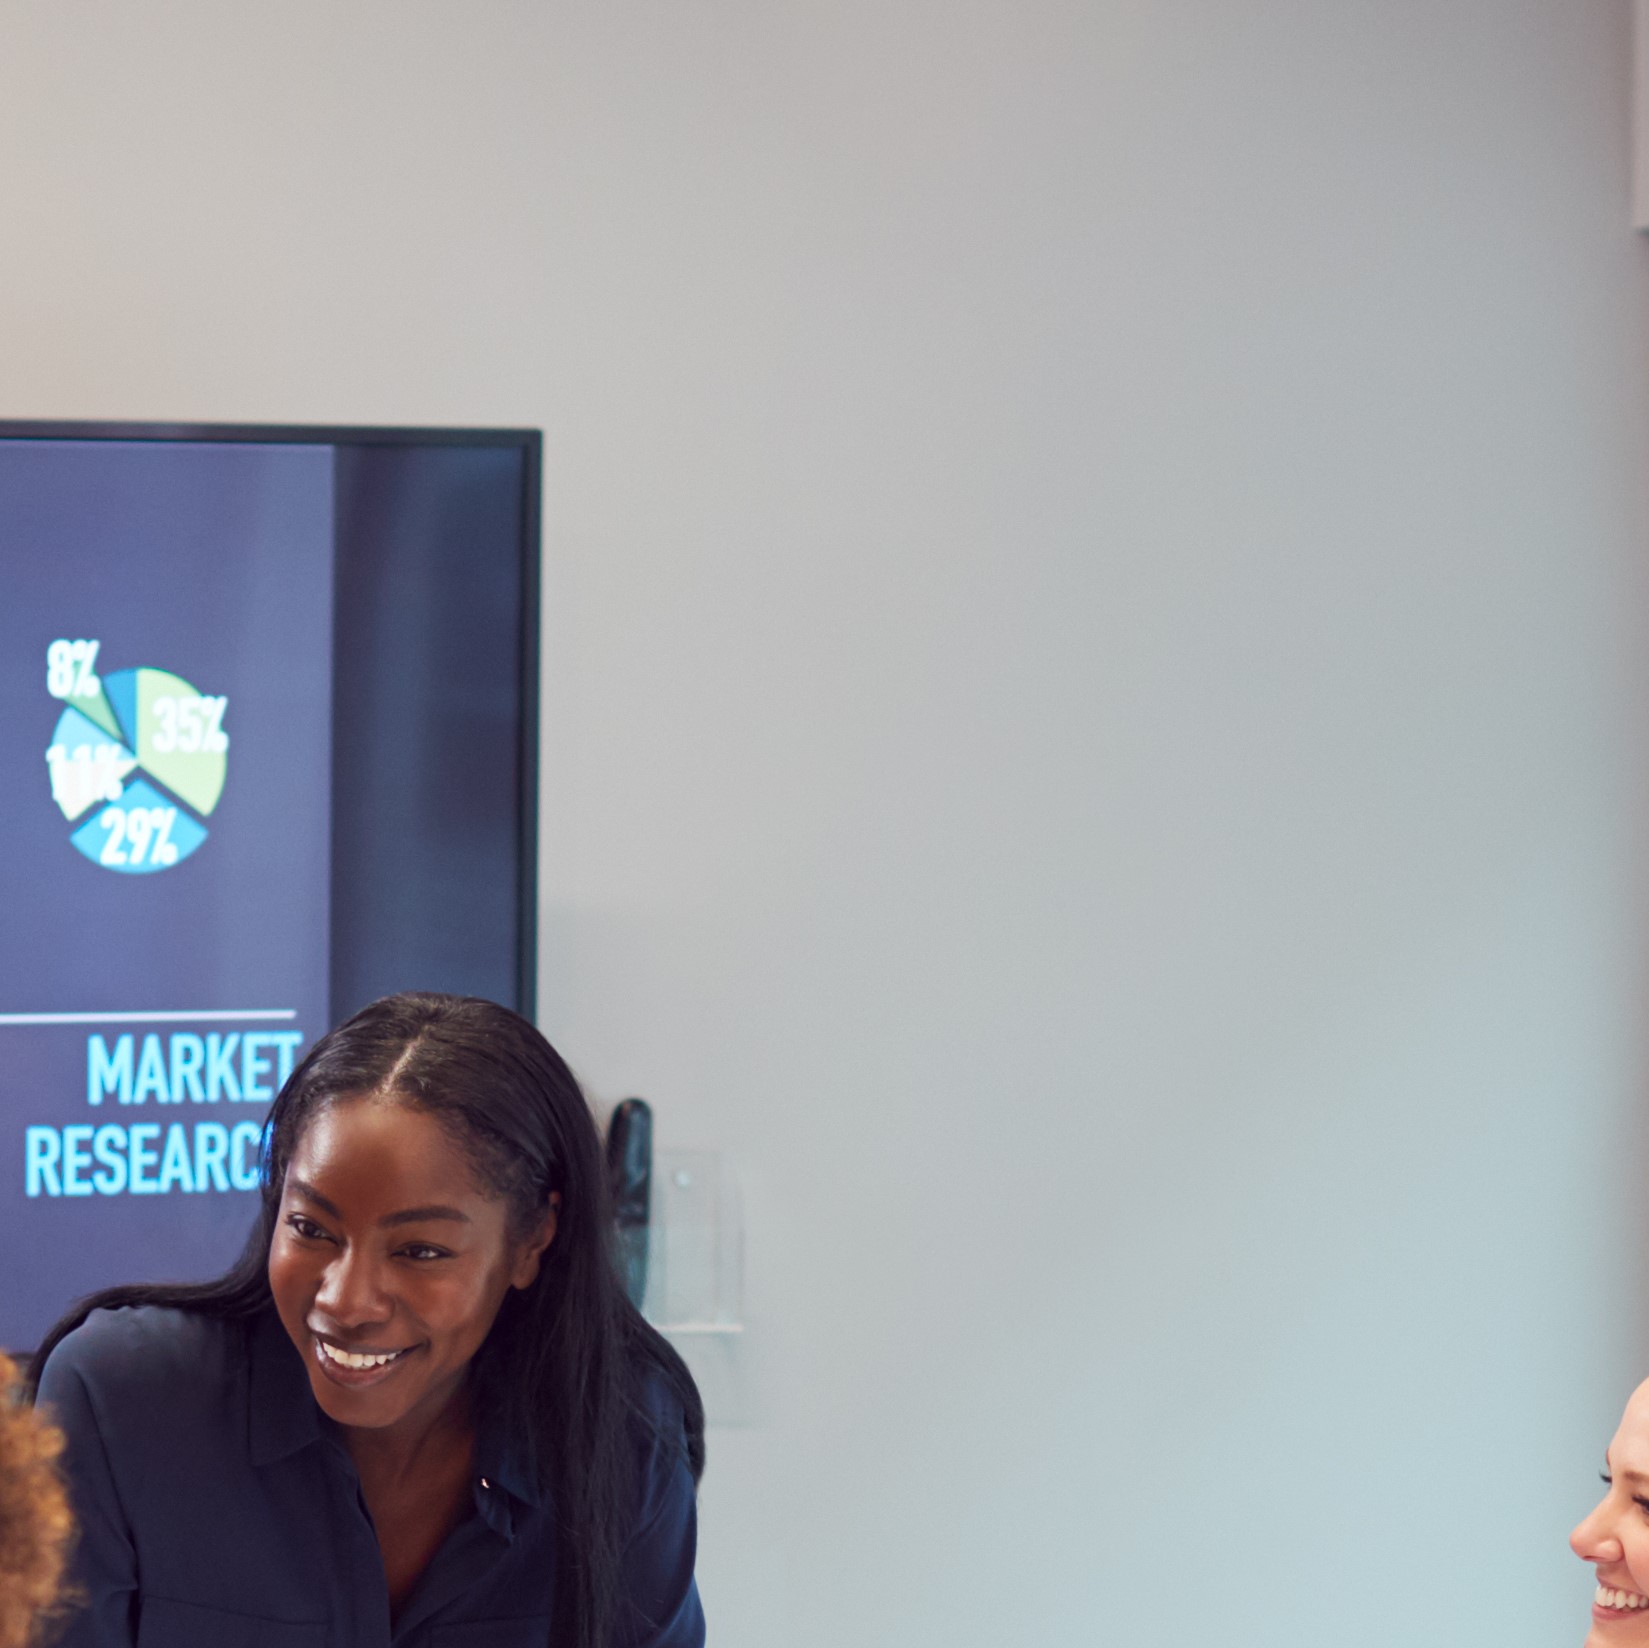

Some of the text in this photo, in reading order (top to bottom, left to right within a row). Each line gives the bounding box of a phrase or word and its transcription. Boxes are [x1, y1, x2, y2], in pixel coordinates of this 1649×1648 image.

[47, 638, 102, 699] 8%
[152, 694, 230, 754] 35%
[99, 805, 179, 867] 29%
[86, 1030, 304, 1106] MARKET
